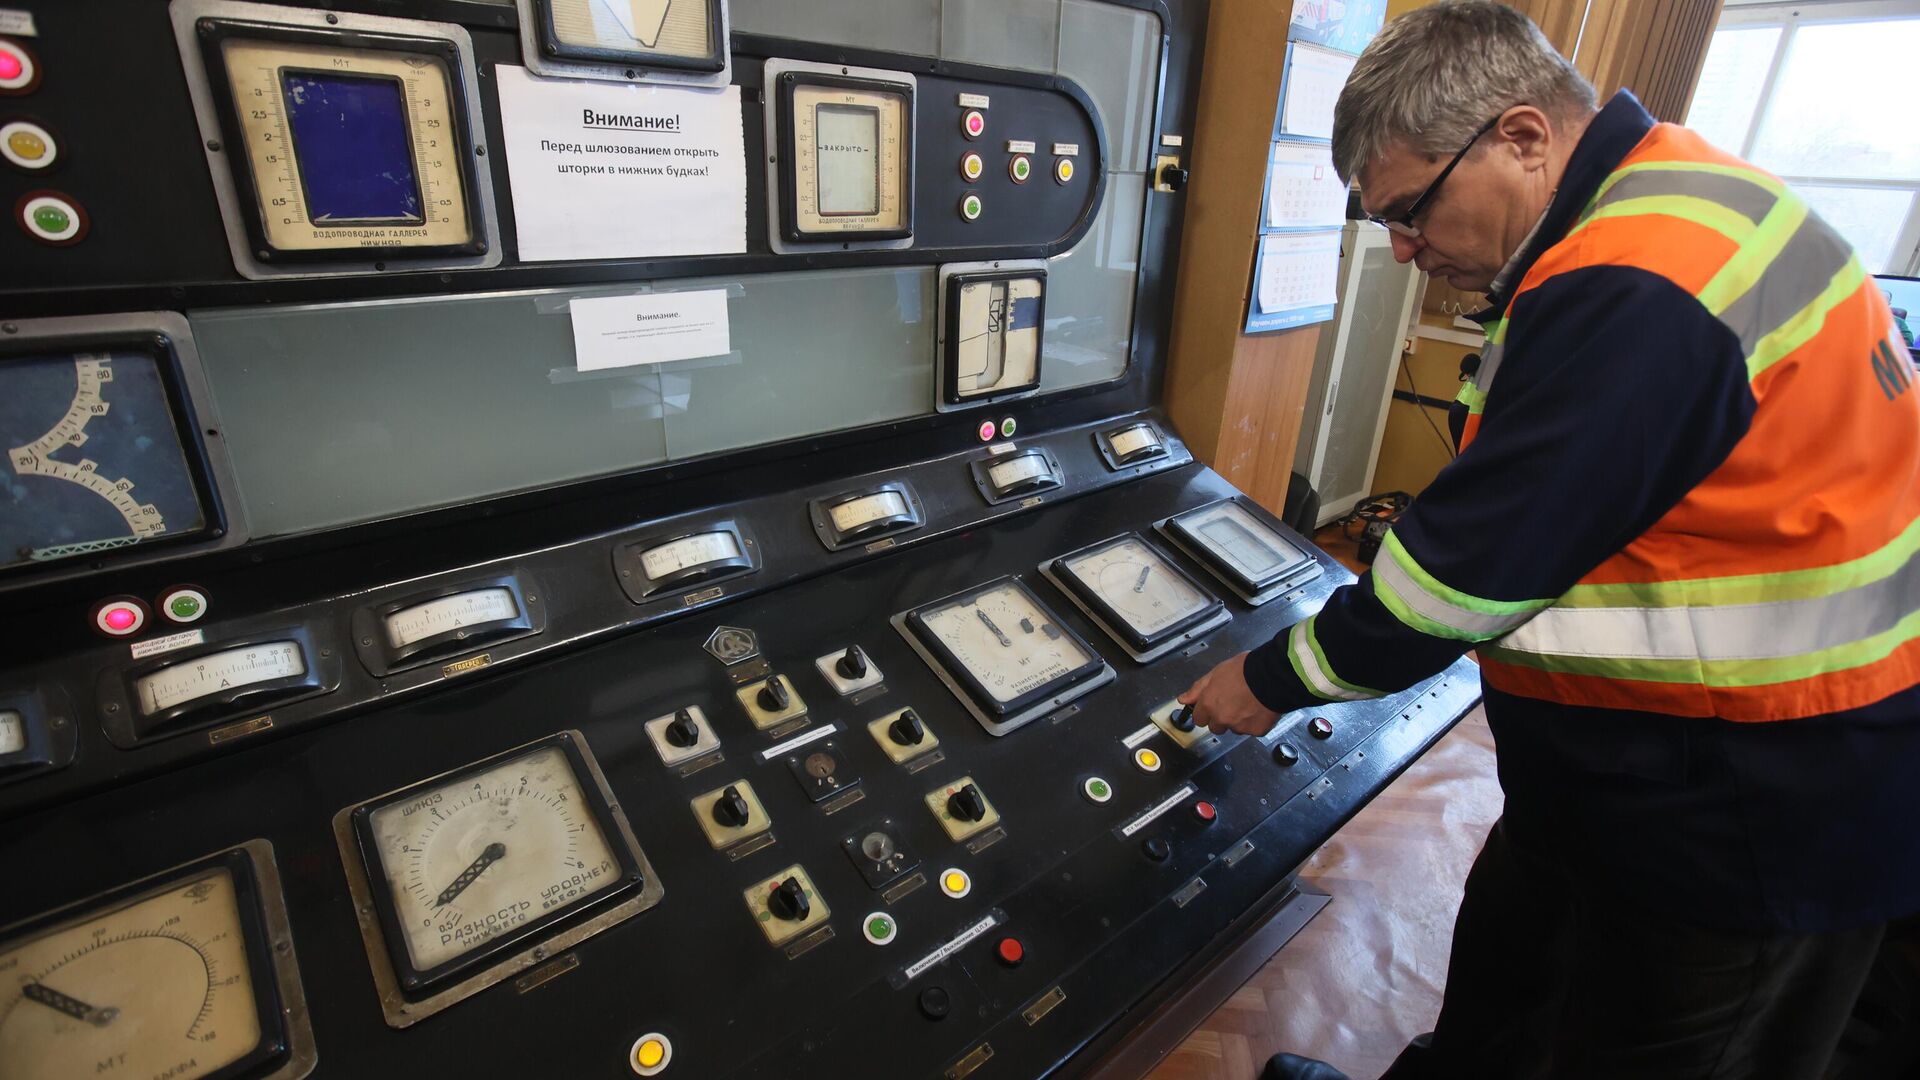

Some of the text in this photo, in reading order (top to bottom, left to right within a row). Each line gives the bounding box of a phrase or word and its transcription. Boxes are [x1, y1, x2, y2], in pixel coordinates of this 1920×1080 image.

[255, 89, 262, 97] 3
[424, 99, 431, 107] 3
[583, 109, 681, 130] Внимание!
[264, 133, 272, 141] 2
[541, 140, 719, 159] Перед шлюзованием открыть
[558, 164, 709, 177] шторки в нижних будках!
[313, 229, 428, 239] ВОДОПРОВОДНАЯ ГАЛЛЕРЕЯ
[636, 311, 681, 322] Внимание.
[91, 404, 104, 413] 60
[20, 456, 33, 465] 20
[80, 464, 92, 472] 40
[116, 482, 129, 491] 60
[142, 507, 156, 515] 80
[520, 776, 528, 786] 5
[473, 782, 482, 791] 4
[559, 793, 567, 801] 6
[402, 793, 443, 817] ШЛЮЗ
[430, 807, 438, 816] 3
[579, 823, 586, 832] 7
[402, 845, 410, 853] 2
[576, 861, 585, 869] 8
[440, 861, 613, 947] РАЗНОСТЬ УРОВНЕЙ
[423, 918, 431, 928] 0
[462, 912, 526, 948] НИЖНЕГО
[911, 953, 941, 974] Включение
[943, 932, 974, 953] Выключение
